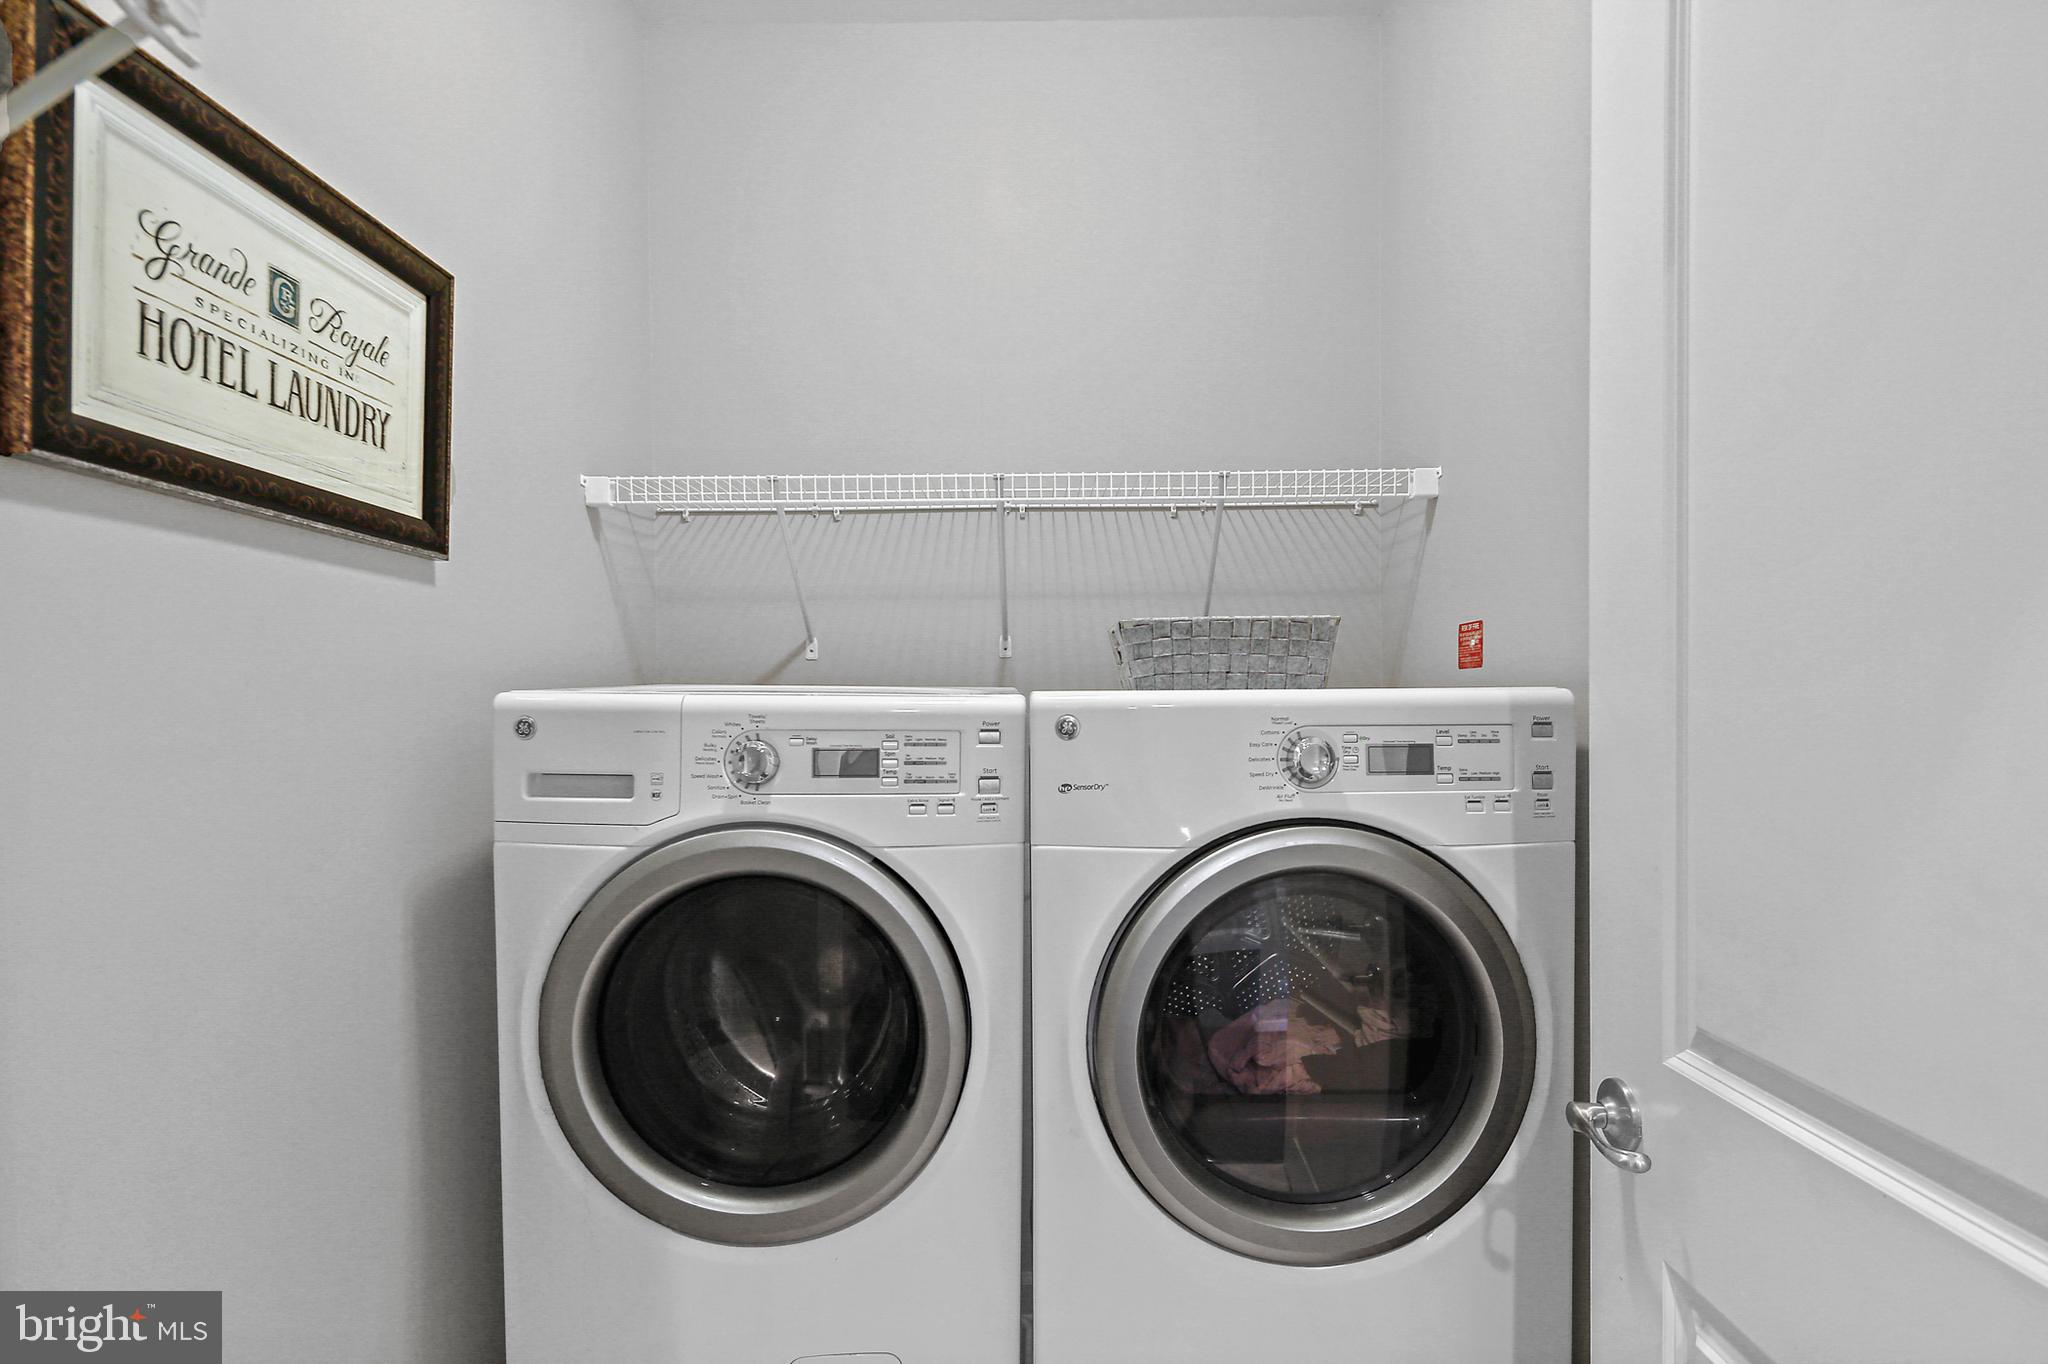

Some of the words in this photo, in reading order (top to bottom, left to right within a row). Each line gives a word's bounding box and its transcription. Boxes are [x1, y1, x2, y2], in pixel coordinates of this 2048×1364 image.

[138, 209, 257, 297] Grande
[308, 298, 390, 368] Royale
[194, 296, 330, 370] SPECIALIZING
[136, 298, 259, 400] HOTEL
[267, 359, 392, 451] LAUNDRY
